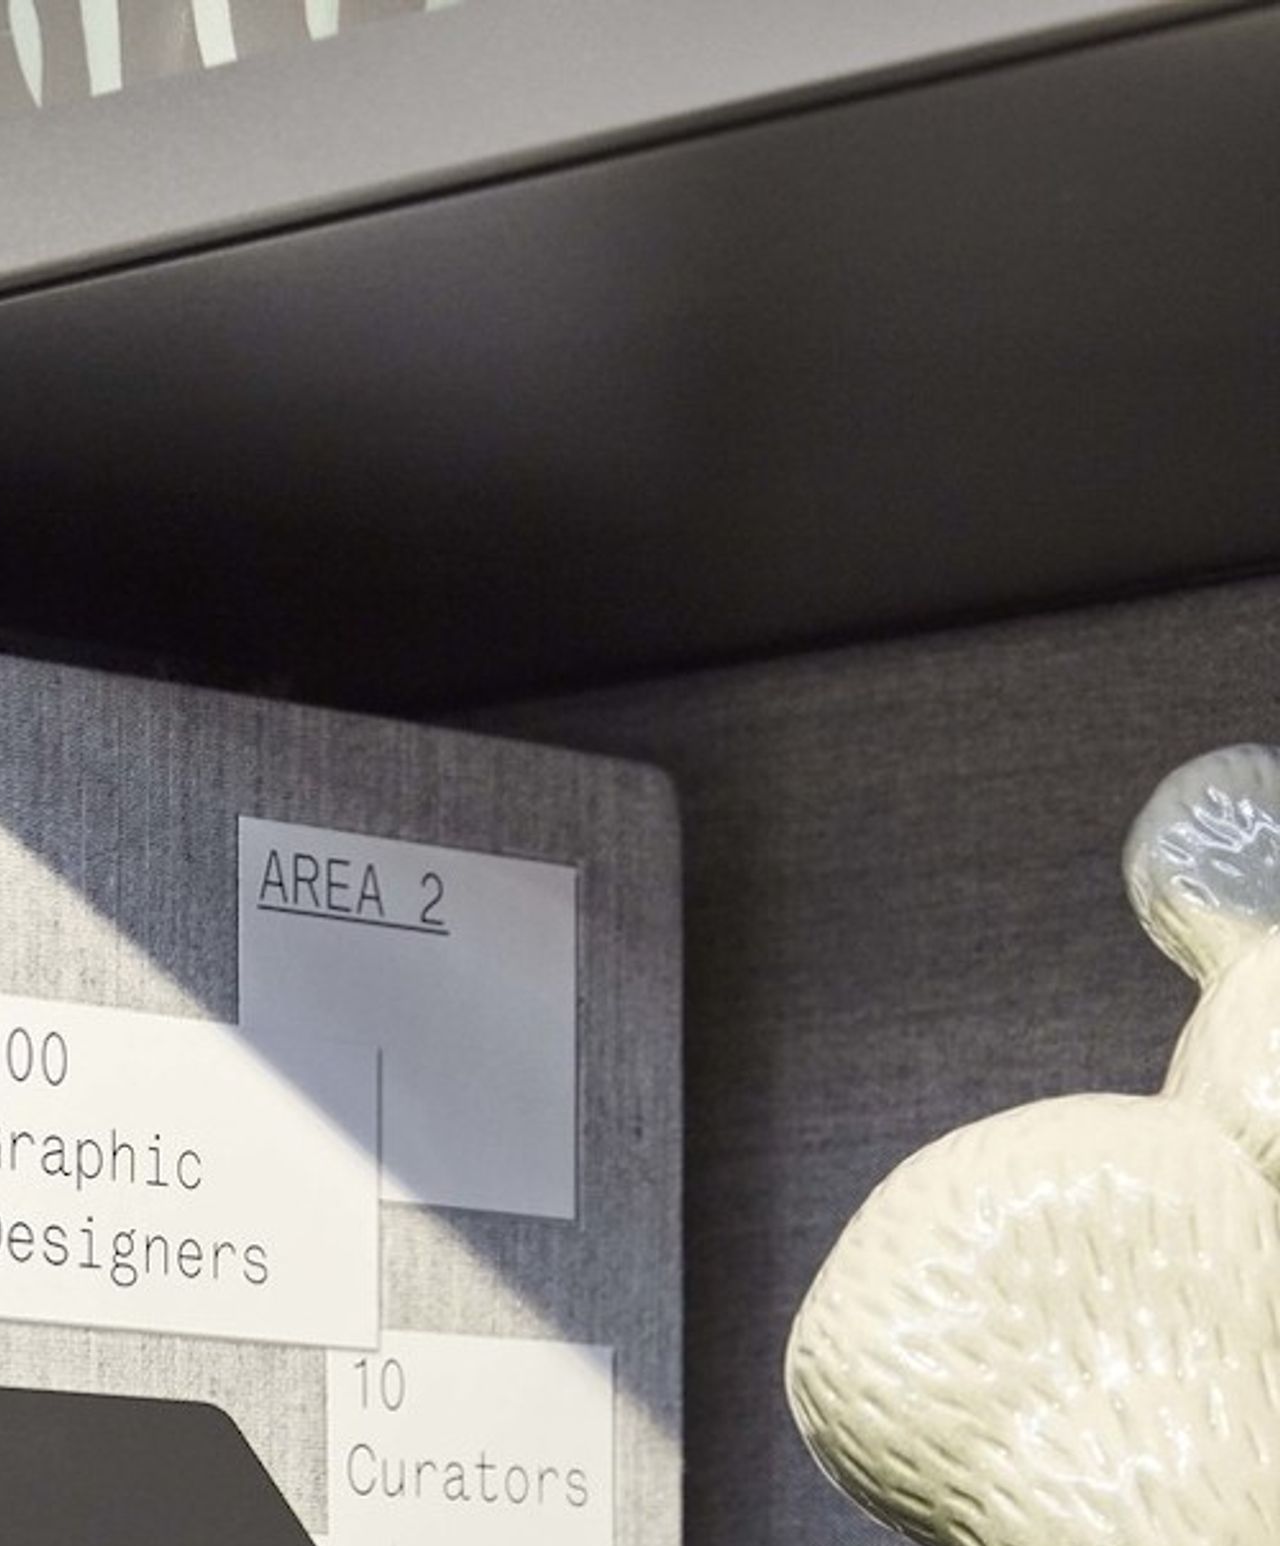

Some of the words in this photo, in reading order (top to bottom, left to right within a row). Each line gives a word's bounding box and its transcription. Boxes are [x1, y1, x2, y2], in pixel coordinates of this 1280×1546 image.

[259, 848, 386, 918] AREA
[420, 872, 447, 927] 2
[352, 1357, 406, 1412] 10
[346, 1444, 590, 1509] Curators
